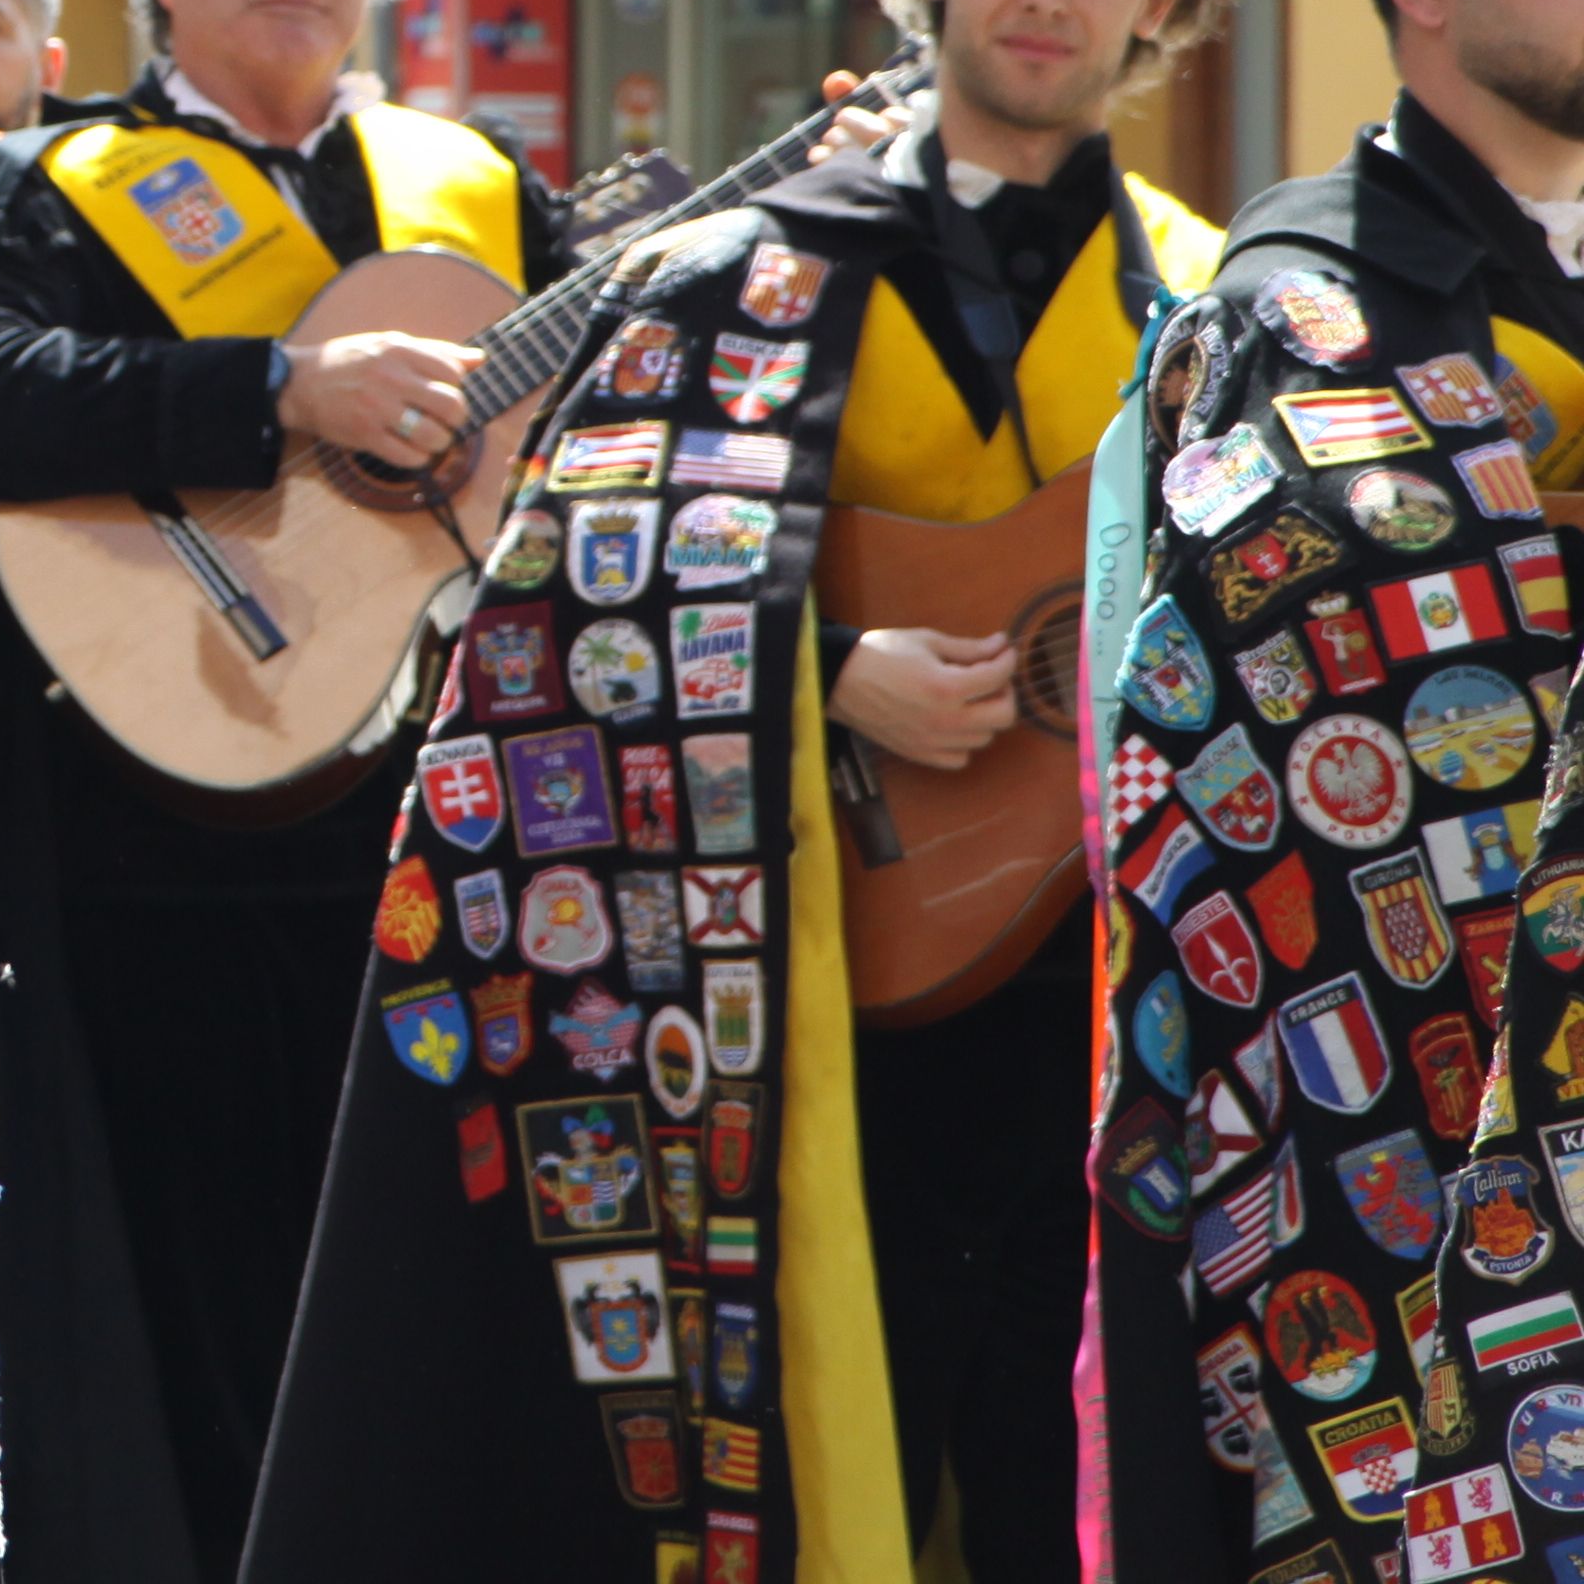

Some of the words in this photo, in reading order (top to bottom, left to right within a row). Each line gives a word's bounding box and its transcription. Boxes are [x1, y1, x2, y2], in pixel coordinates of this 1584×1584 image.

[671, 545, 760, 568] MIAMI
[1291, 719, 1383, 771] POLSKA
[1327, 798, 1407, 842] POLAND
[1289, 989, 1346, 1023] FRANCE
[572, 1047, 634, 1070] COLCA
[1464, 1168, 1523, 1203] Tallinn
[1489, 1254, 1532, 1273] ESTONIA
[1506, 1350, 1560, 1376] SOFIA
[1323, 1410, 1396, 1445] CROATIA
